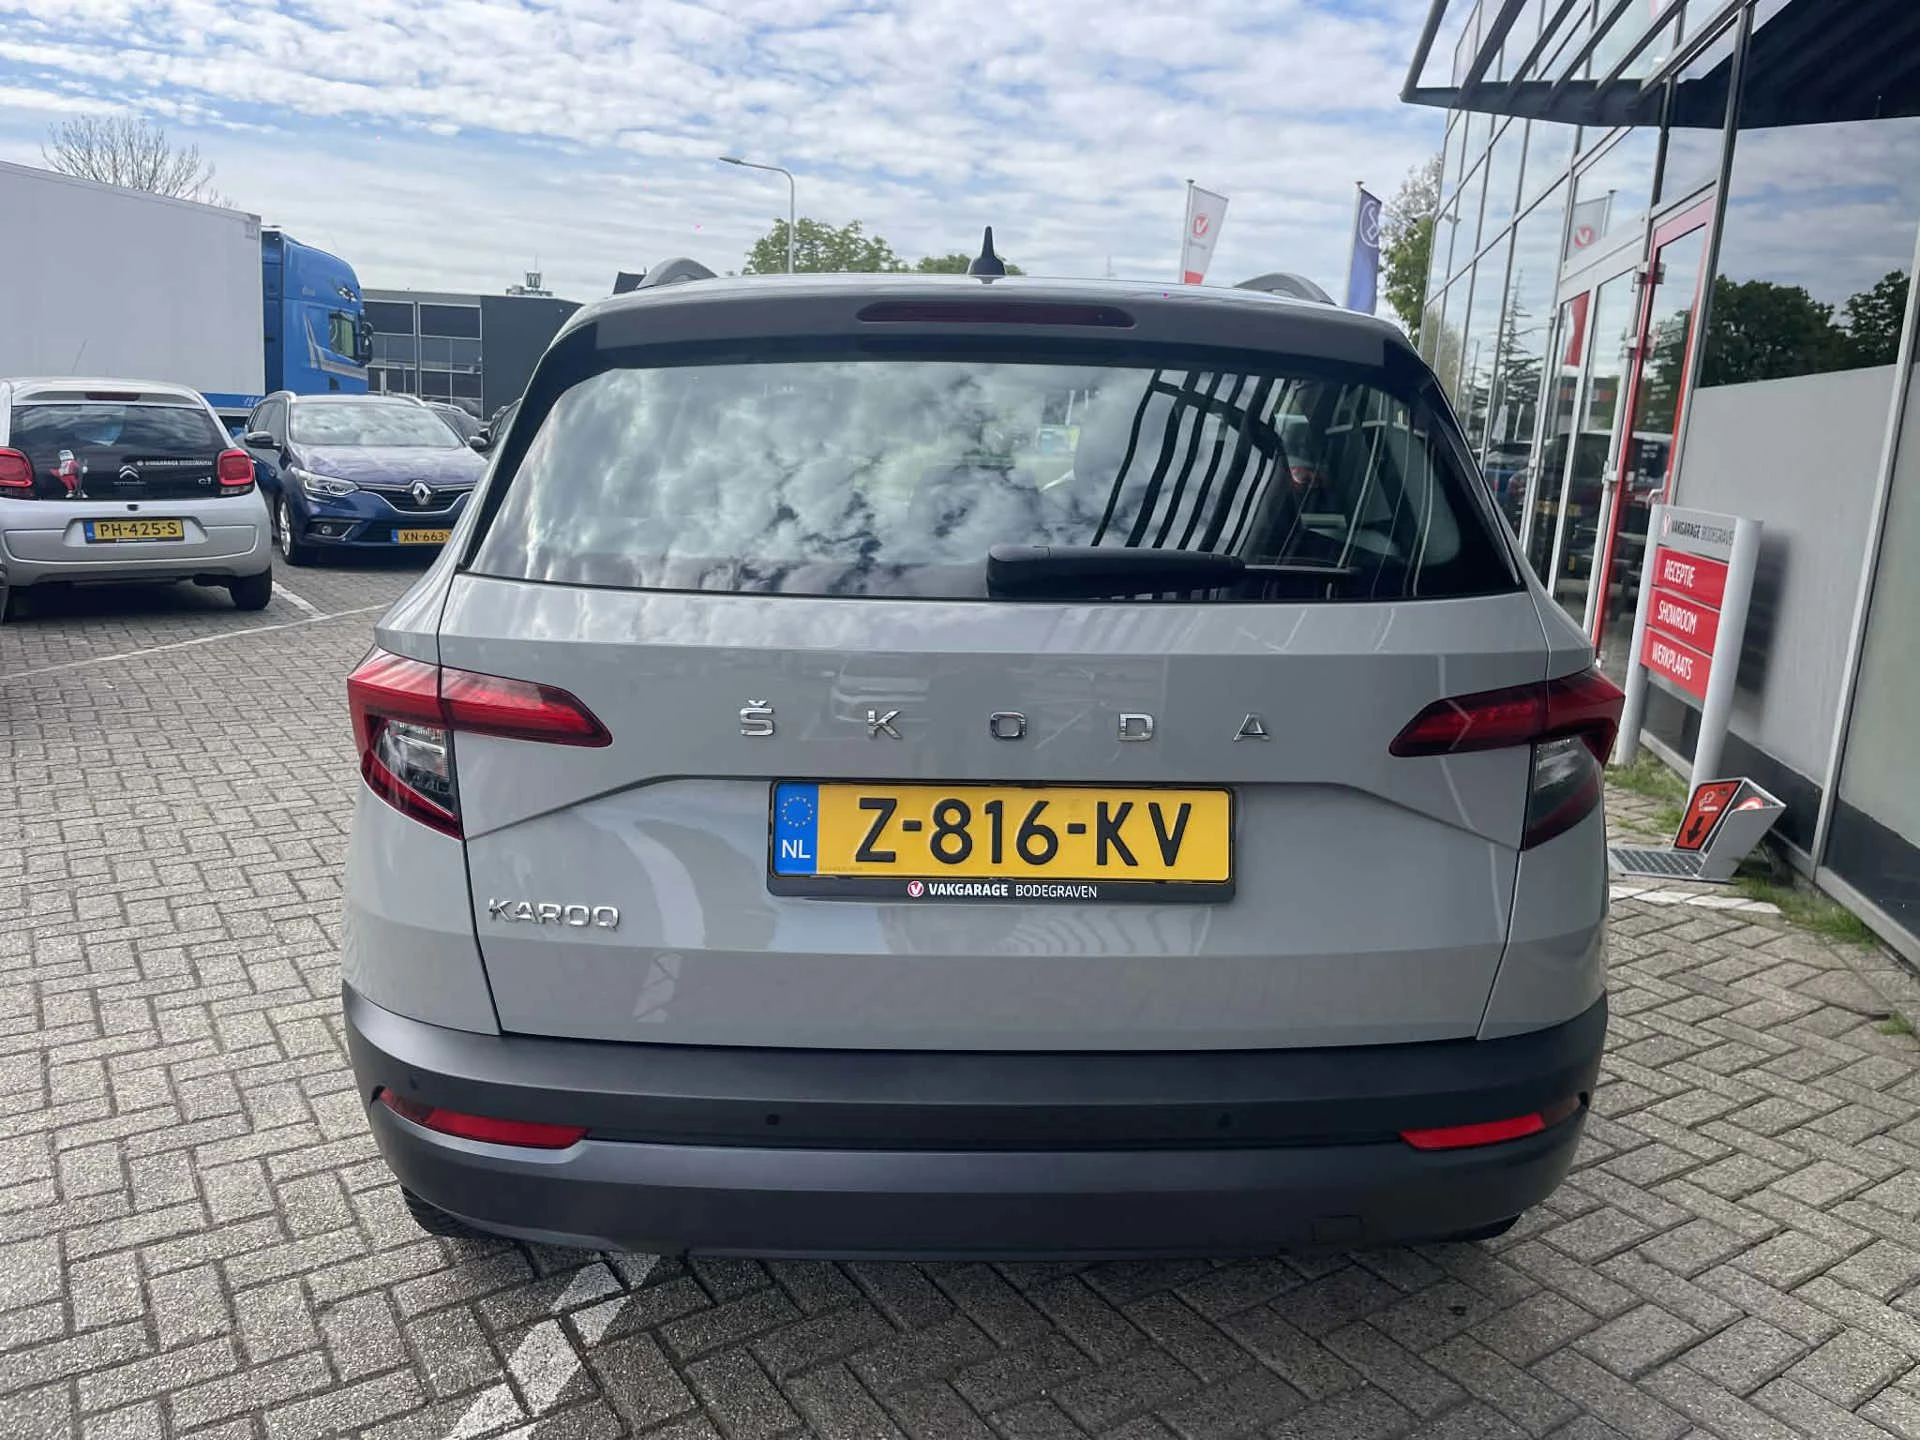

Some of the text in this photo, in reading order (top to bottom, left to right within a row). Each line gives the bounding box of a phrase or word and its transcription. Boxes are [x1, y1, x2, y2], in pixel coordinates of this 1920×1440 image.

[99, 522, 178, 538] PH-425-S
[403, 531, 452, 542] XN-663-
[1663, 558, 1696, 589] RECEPTIE
[1657, 599, 1698, 636] SHOWROOM
[1651, 640, 1694, 681] WERKPLAATS
[738, 699, 1272, 742] ŠKODA
[855, 797, 1192, 867] Z-816-KV
[781, 839, 812, 859] NL
[928, 883, 1009, 897] VAKGARAGE
[1015, 884, 1097, 899] BODEGRAVEN
[488, 898, 620, 932] KAROQ
